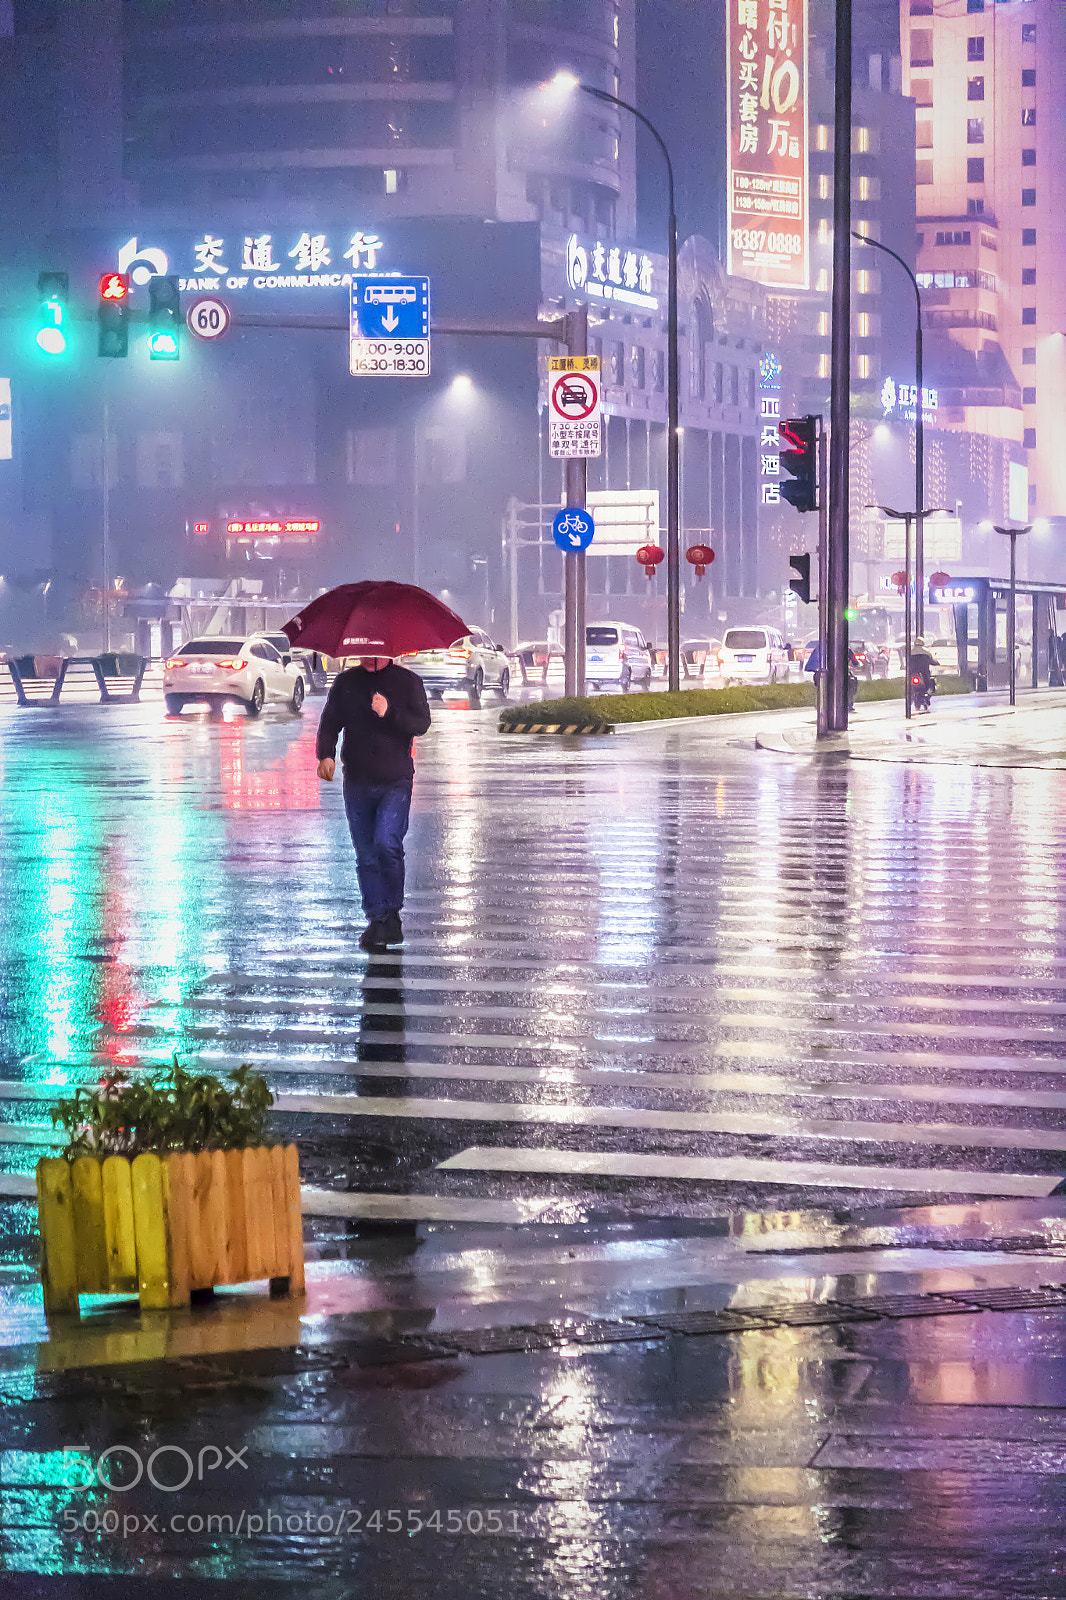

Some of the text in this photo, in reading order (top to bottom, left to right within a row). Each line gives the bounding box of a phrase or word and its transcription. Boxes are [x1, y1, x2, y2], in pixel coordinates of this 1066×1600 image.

[226, 276, 249, 289] OF
[197, 308, 220, 330] 60
[355, 359, 426, 371] 16:30-18:30
[760, 397, 780, 504] 亚朵酒店
